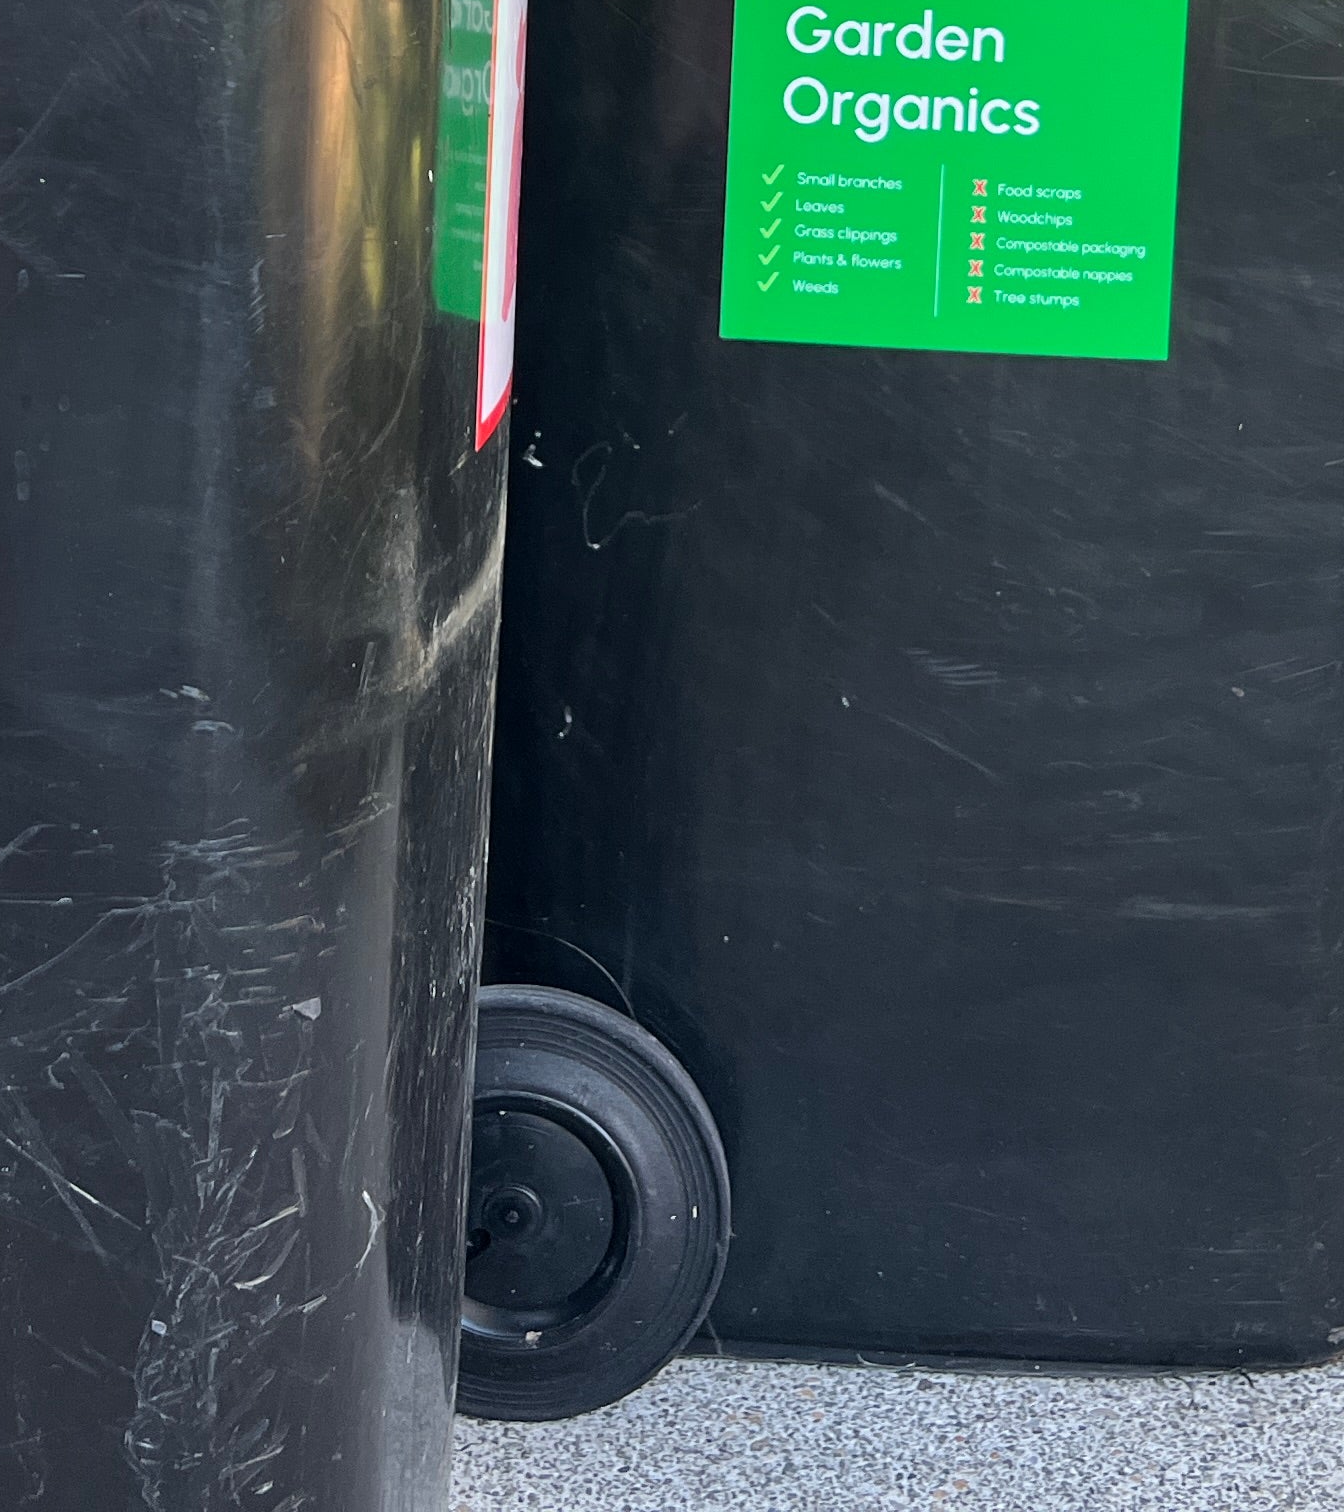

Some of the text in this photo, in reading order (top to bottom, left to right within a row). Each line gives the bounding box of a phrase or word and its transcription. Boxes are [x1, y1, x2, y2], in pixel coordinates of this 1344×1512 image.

[785, 5, 1004, 63] Garden
[782, 76, 1040, 143] Organics
[797, 172, 903, 190] Small branches
[997, 183, 1081, 202] Food scraps
[795, 199, 845, 214] Leaves
[997, 210, 1073, 228] Woodchips
[794, 223, 898, 245] Grass clippings
[996, 237, 1146, 259] Compostable packaging
[793, 251, 902, 270] Plants & flowers
[993, 263, 1133, 284] Compostable nappies
[792, 279, 839, 294] Weeds
[993, 289, 1080, 309] Tree stumps
